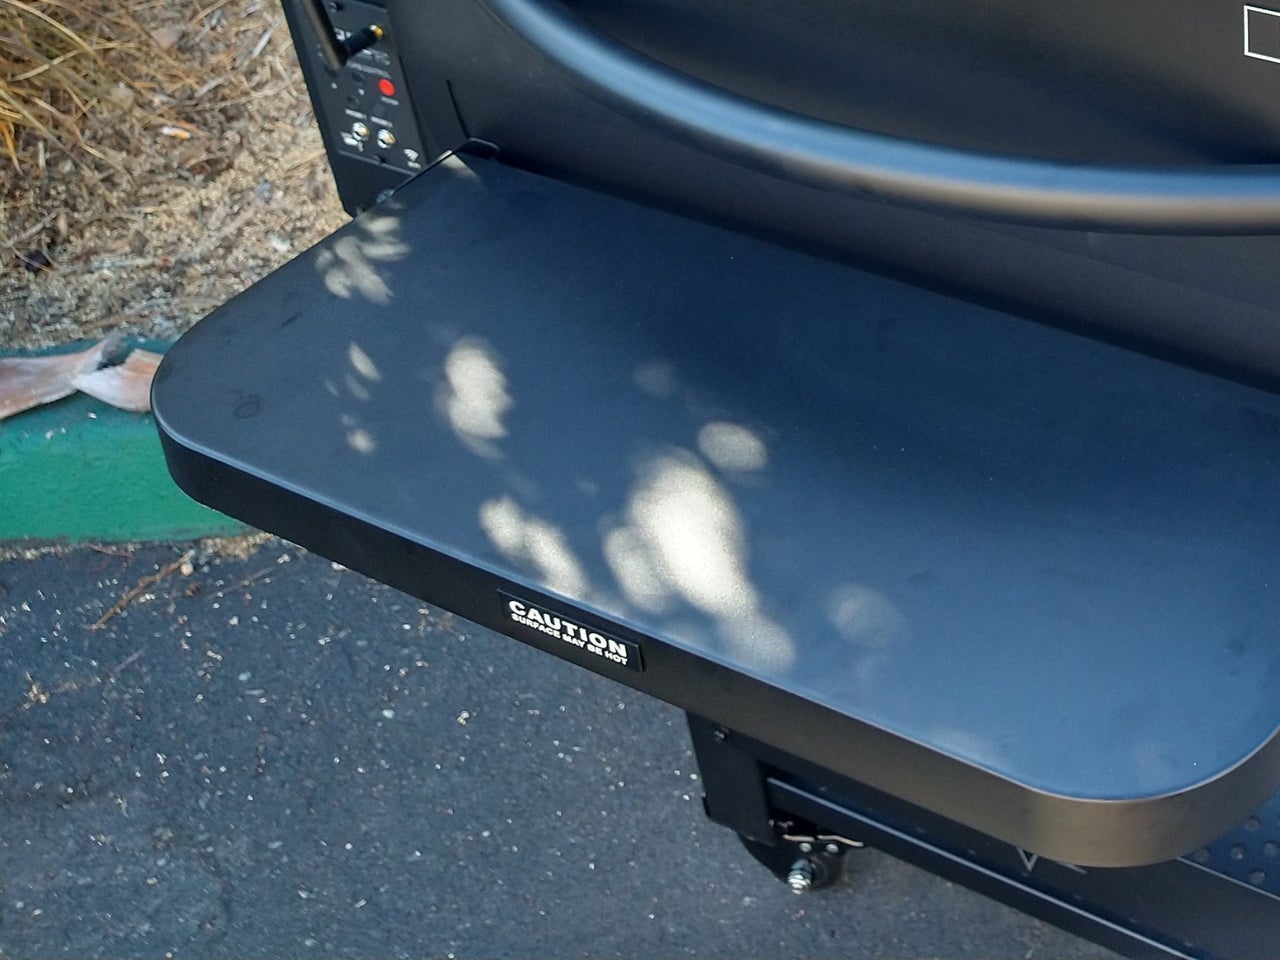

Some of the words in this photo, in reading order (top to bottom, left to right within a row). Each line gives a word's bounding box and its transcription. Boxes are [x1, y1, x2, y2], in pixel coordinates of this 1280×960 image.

[508, 600, 628, 658] CAUTION
[511, 613, 561, 639] SURFACE
[562, 633, 586, 649] MAY
[587, 643, 603, 656] BE
[604, 650, 628, 666] HOT
